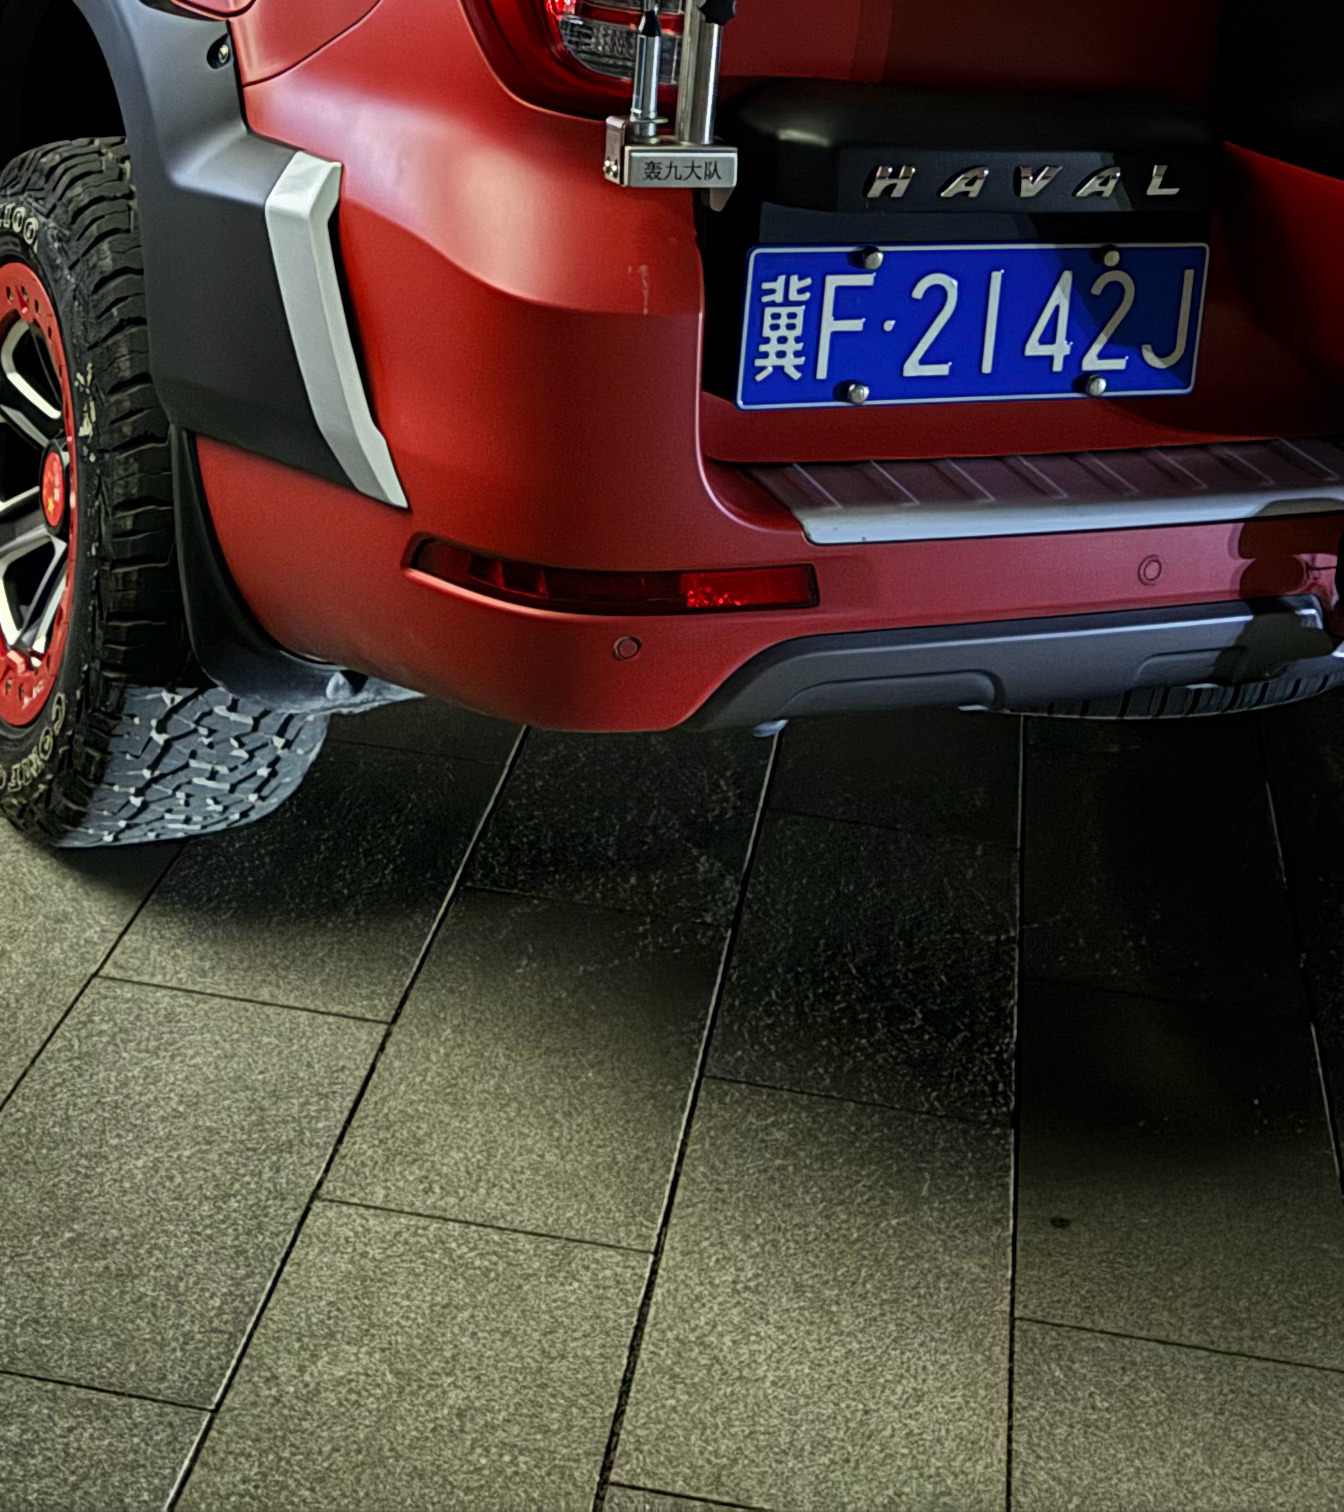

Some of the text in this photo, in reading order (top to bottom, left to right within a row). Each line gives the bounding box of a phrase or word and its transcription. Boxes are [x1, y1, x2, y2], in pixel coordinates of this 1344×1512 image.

[642, 160, 723, 182] 轰九大队
[866, 164, 1181, 198] HAVAL
